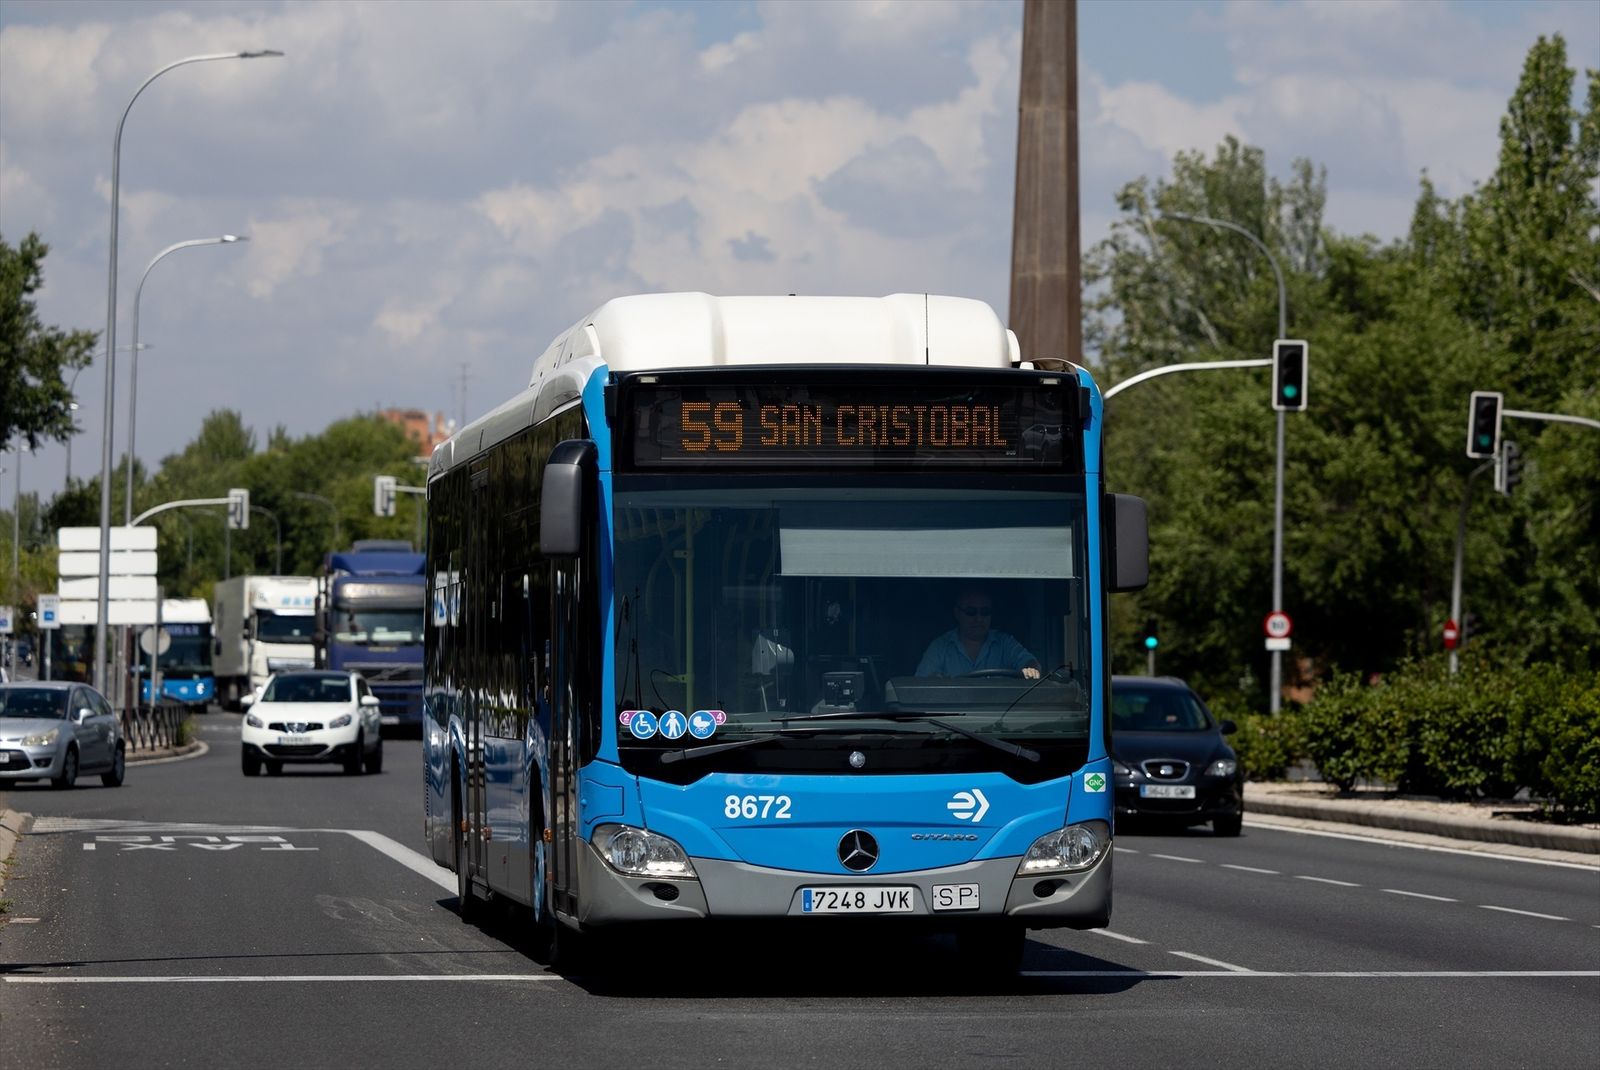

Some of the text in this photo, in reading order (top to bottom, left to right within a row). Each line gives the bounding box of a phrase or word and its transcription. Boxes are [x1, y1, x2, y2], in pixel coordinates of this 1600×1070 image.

[682, 402, 1007, 451] 59 SAN CRISTOBAL
[623, 713, 630, 721] 2
[716, 712, 723, 721] 4
[1088, 779, 1103, 787] GNC
[724, 795, 792, 819] 8672
[911, 832, 979, 842] CITARO
[814, 890, 910, 910] 7248 JVK
